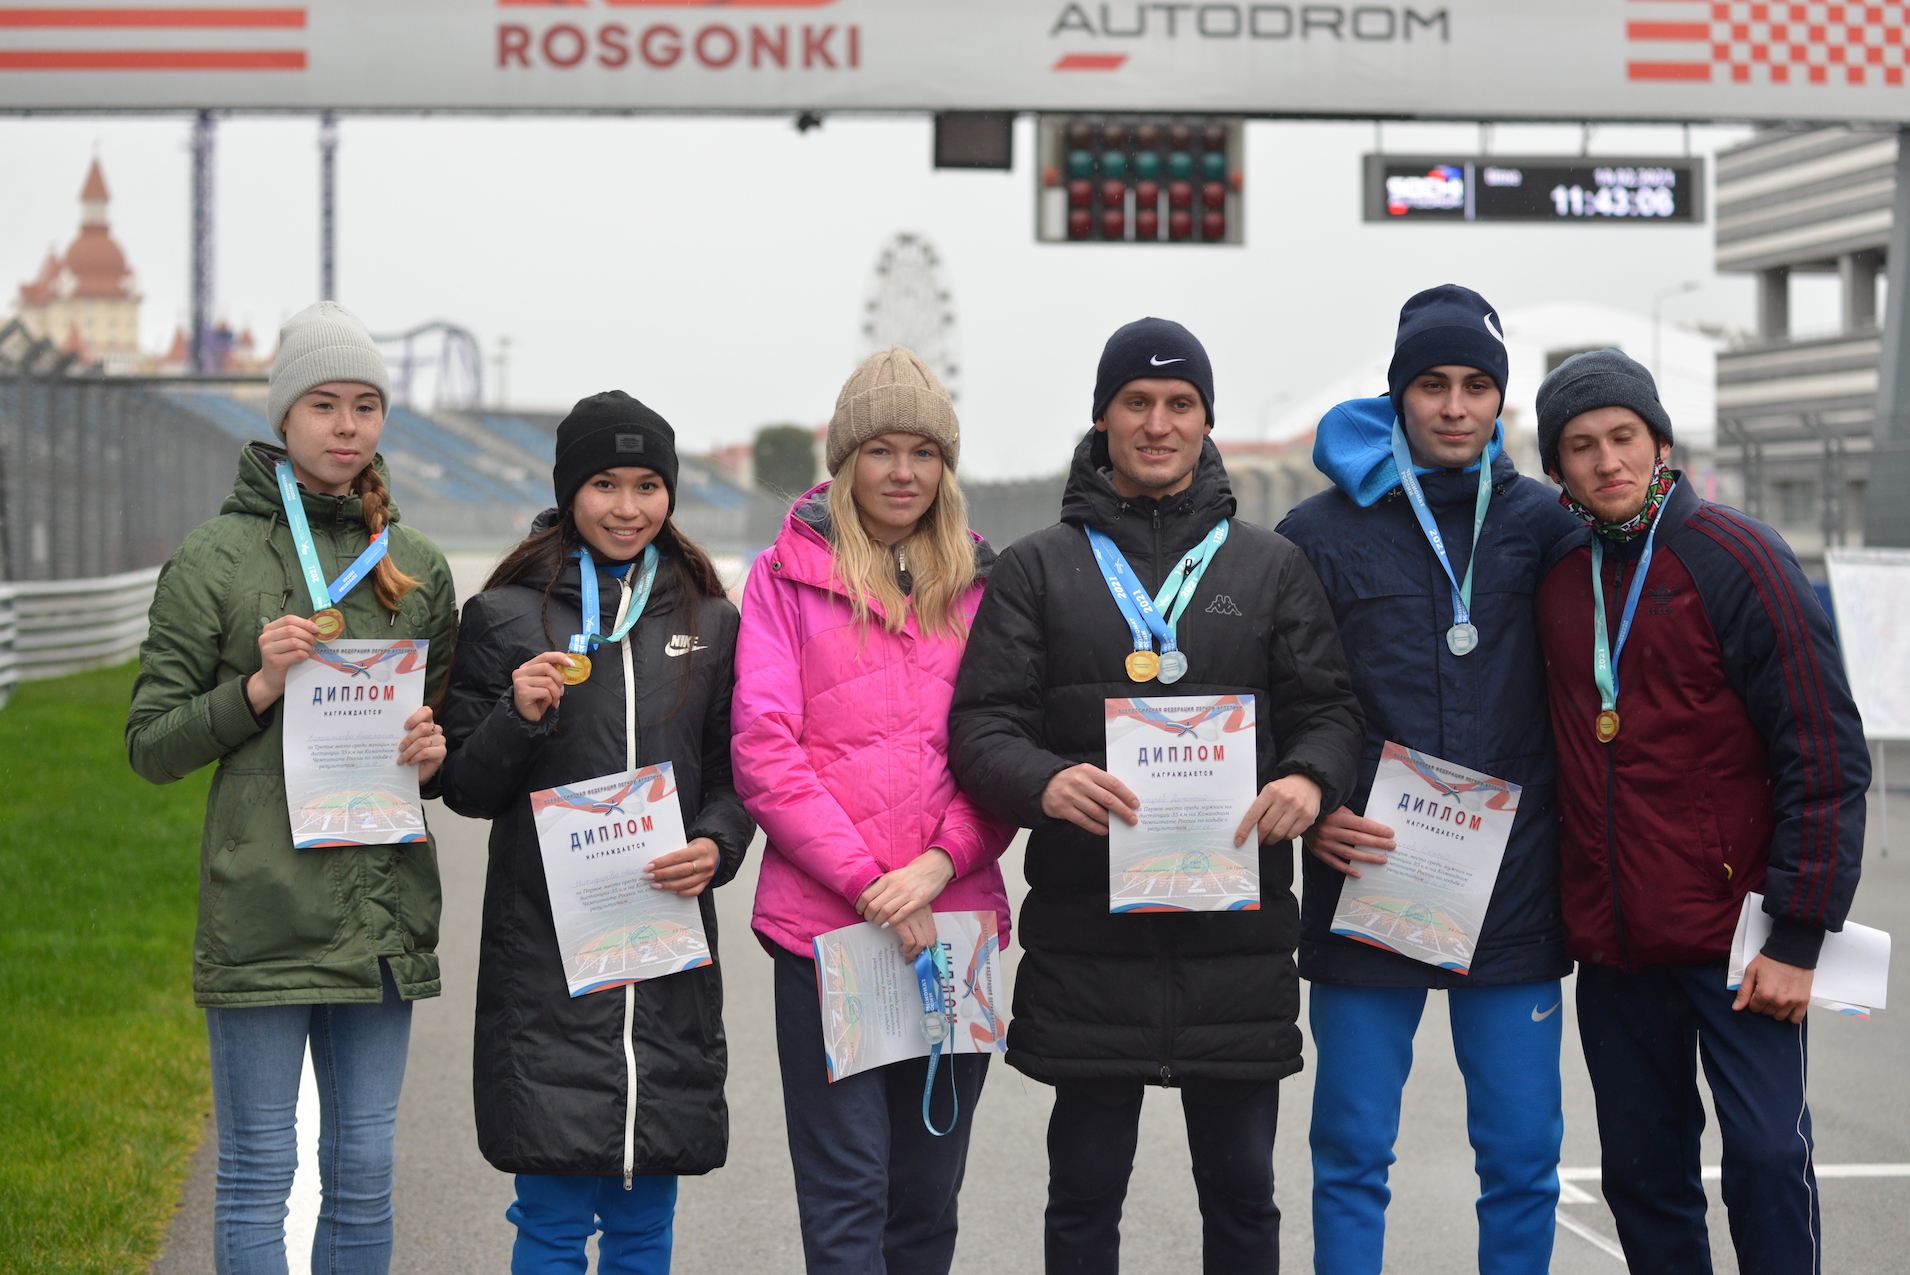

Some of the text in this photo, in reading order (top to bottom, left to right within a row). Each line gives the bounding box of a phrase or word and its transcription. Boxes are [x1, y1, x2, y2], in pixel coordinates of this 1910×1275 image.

[1050, 2, 1451, 42] AUTODROM
[497, 23, 861, 70] ROSGONKI
[1551, 185, 1675, 217] 11:43:06
[1401, 471, 1413, 497] РОССИИ
[1406, 468, 1425, 507] ЧЕМПИОНАТ
[1213, 527, 1225, 545] 2021
[1429, 529, 1446, 556] 2021
[308, 565, 320, 583] 2021
[1109, 577, 1127, 599] 2021
[1181, 576, 1199, 599] 2021
[1133, 589, 1153, 613] 2021
[312, 685, 394, 705] ДИПЛОМ
[1138, 745, 1223, 766] ДИПЛОМ
[1435, 766, 1464, 779] ФЕДЕРАЦИЯ
[587, 783, 616, 795] ФЕДЕРАЦИЯ
[1397, 793, 1481, 830] ДИПЛОМ
[570, 815, 652, 851] ДИПЛОМ
[1406, 819, 1464, 840] НАГРАЖДАЕТСЯ
[586, 841, 645, 859] НАГРАЖДАЕТСЯ
[1408, 854, 1426, 862] место
[1442, 865, 1465, 874] мужчин
[582, 886, 602, 894] Первое
[603, 881, 621, 889] место
[886, 978, 892, 986] 35
[887, 986, 891, 994] км
[985, 966, 993, 995] ФЕДЕРАЦИЯ
